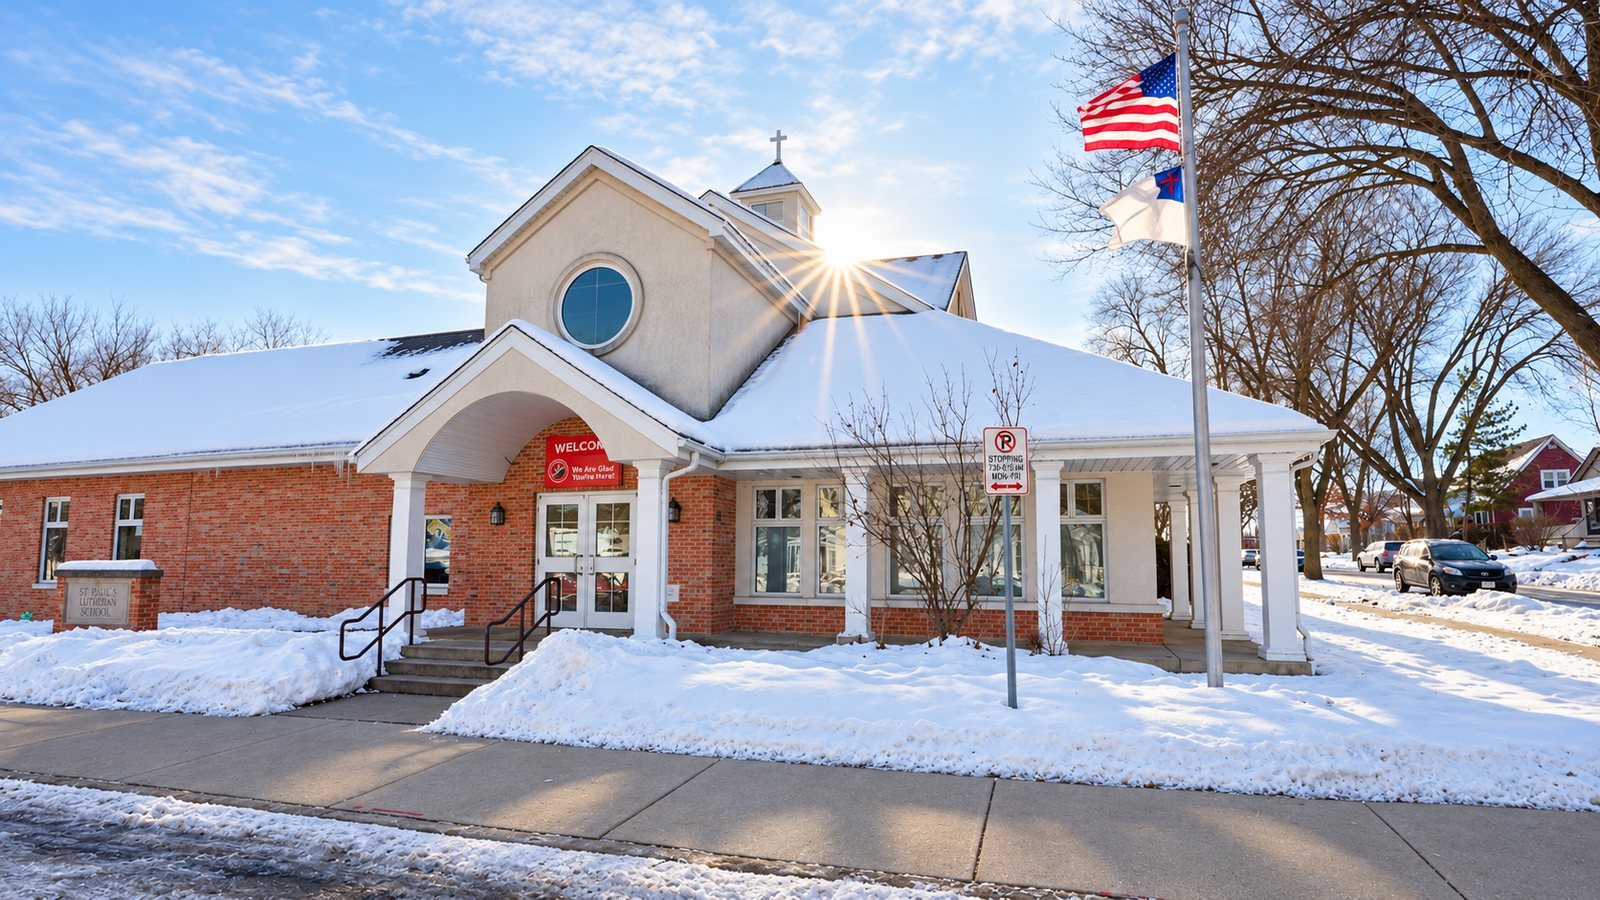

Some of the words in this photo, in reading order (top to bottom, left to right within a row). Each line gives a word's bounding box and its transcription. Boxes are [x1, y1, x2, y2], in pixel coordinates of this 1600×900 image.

[988, 455, 1024, 463] STOPPING
[584, 465, 597, 473] Are
[598, 464, 615, 472] Glad
[79, 597, 117, 607] LUTHERAN
[80, 607, 111, 617] SCHOOL
